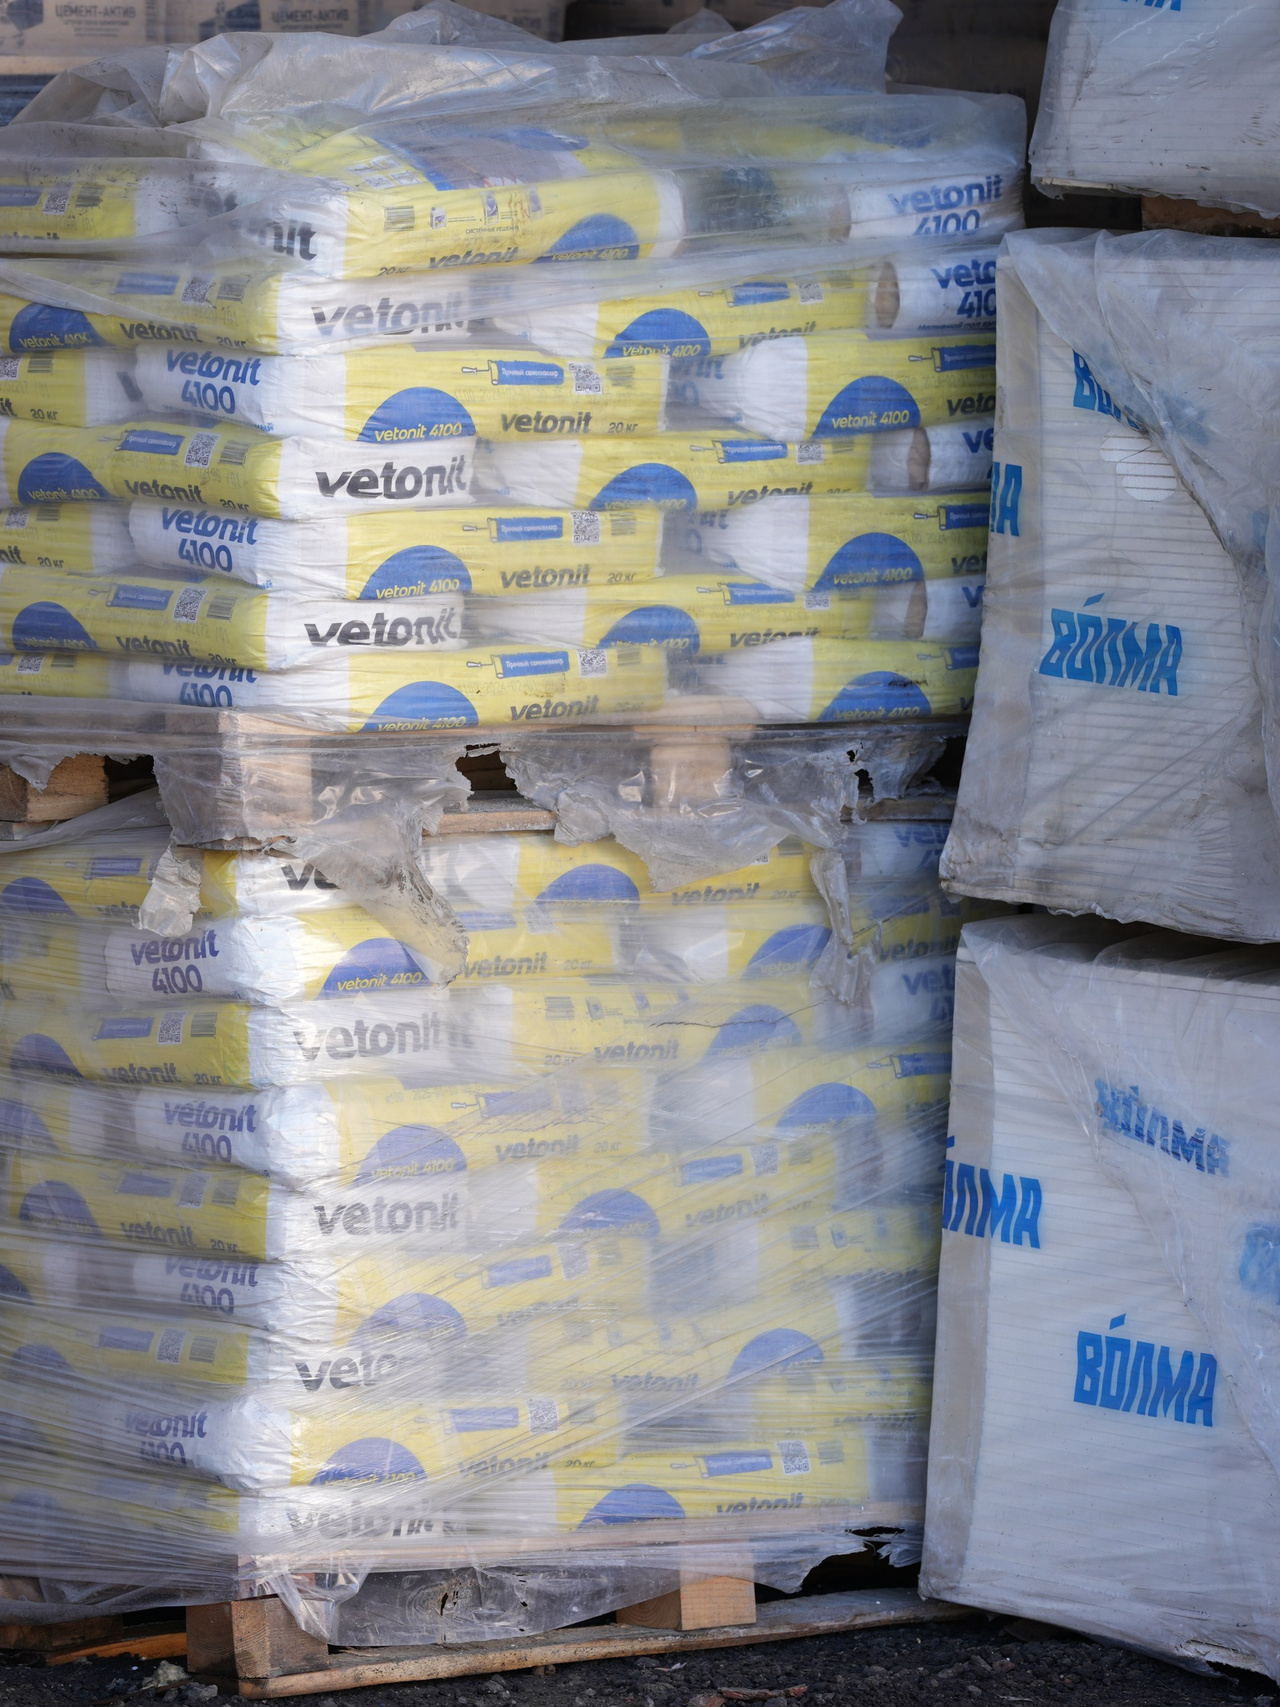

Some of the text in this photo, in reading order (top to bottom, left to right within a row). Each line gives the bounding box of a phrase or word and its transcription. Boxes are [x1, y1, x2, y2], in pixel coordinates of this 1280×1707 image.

[55, 4, 137, 19] ЦЕМЕНТ-АКТИВ
[270, 9, 350, 25] ЦЕМЕНТ-АКТИВ
[886, 174, 1004, 215] vetonit
[465, 227, 494, 235] СИСТЕМНЫЕ
[912, 209, 981, 237] 4100
[428, 246, 519, 271] vetonit
[551, 247, 630, 261] vetonit 4100
[378, 266, 397, 277] 20
[310, 290, 464, 337] vetonit
[19, 331, 92, 351] vetonit 4100
[119, 321, 203, 344] vetonit
[215, 336, 232, 348] 20
[738, 321, 817, 348] vetonit
[622, 342, 701, 358] vetonit 4100
[165, 348, 262, 386] vetonit
[501, 367, 560, 379] Прочный самонивелир
[181, 380, 237, 415] 4100
[30, 408, 59, 421] 20 кг
[500, 409, 594, 436] vetonit
[831, 409, 910, 429] vetonit 4100
[374, 421, 463, 442] vetonit 4100
[608, 421, 639, 434] 20 кг
[314, 453, 467, 500] vetonit
[26, 488, 101, 500] vetonit 4100
[123, 478, 208, 505] vetonit
[727, 482, 814, 506] vetonit
[219, 498, 250, 512] 20 кг
[161, 506, 259, 546] vetonit
[500, 523, 523, 536] Прочный
[37, 556, 65, 568] 20 кг
[178, 538, 234, 573] 4100
[500, 563, 592, 589] vetonit
[606, 571, 635, 584] 20 кг
[832, 566, 913, 585] vetonit 4100
[375, 578, 460, 599] vetonit 4100
[303, 607, 458, 647] vetonit
[729, 626, 820, 648] vetonit
[115, 634, 193, 658] vetonit
[660, 637, 690, 651] 4100
[1039, 591, 1184, 697] ВО́ЛМА
[208, 652, 223, 663] 20
[504, 659, 528, 670] Прочный
[162, 662, 258, 684] vetonit
[178, 684, 233, 708] 4100
[509, 694, 600, 722] vetonit
[376, 715, 468, 732] vetonit 4100
[834, 705, 920, 721] vetonit 4100
[670, 881, 761, 907] vetonit
[130, 928, 220, 967] vetonit
[462, 951, 549, 979] vetonit
[151, 964, 204, 995] 4100
[336, 970, 424, 992] vetonit 4100
[292, 1011, 444, 1063] vetonit
[593, 1039, 680, 1064] vetonit
[101, 1061, 182, 1086] vetonit
[194, 1072, 209, 1086] 20
[163, 1099, 258, 1134] vetonit
[181, 1132, 233, 1164] 4100
[493, 1133, 580, 1161] vetonit
[593, 1141, 609, 1153] 20
[370, 1157, 456, 1181] vetonit 4100
[313, 1191, 461, 1237] vetonit
[121, 1220, 198, 1249] vetonit
[210, 1239, 226, 1252] 20
[164, 1254, 260, 1288] vetonit
[179, 1282, 235, 1316] 4100
[610, 1372, 699, 1392] vetonit
[1072, 1312, 1219, 1428] ВО́ЛМА
[124, 1409, 210, 1440] vetonit
[457, 1455, 550, 1479] vetonit
[716, 1492, 805, 1513] vetonit
